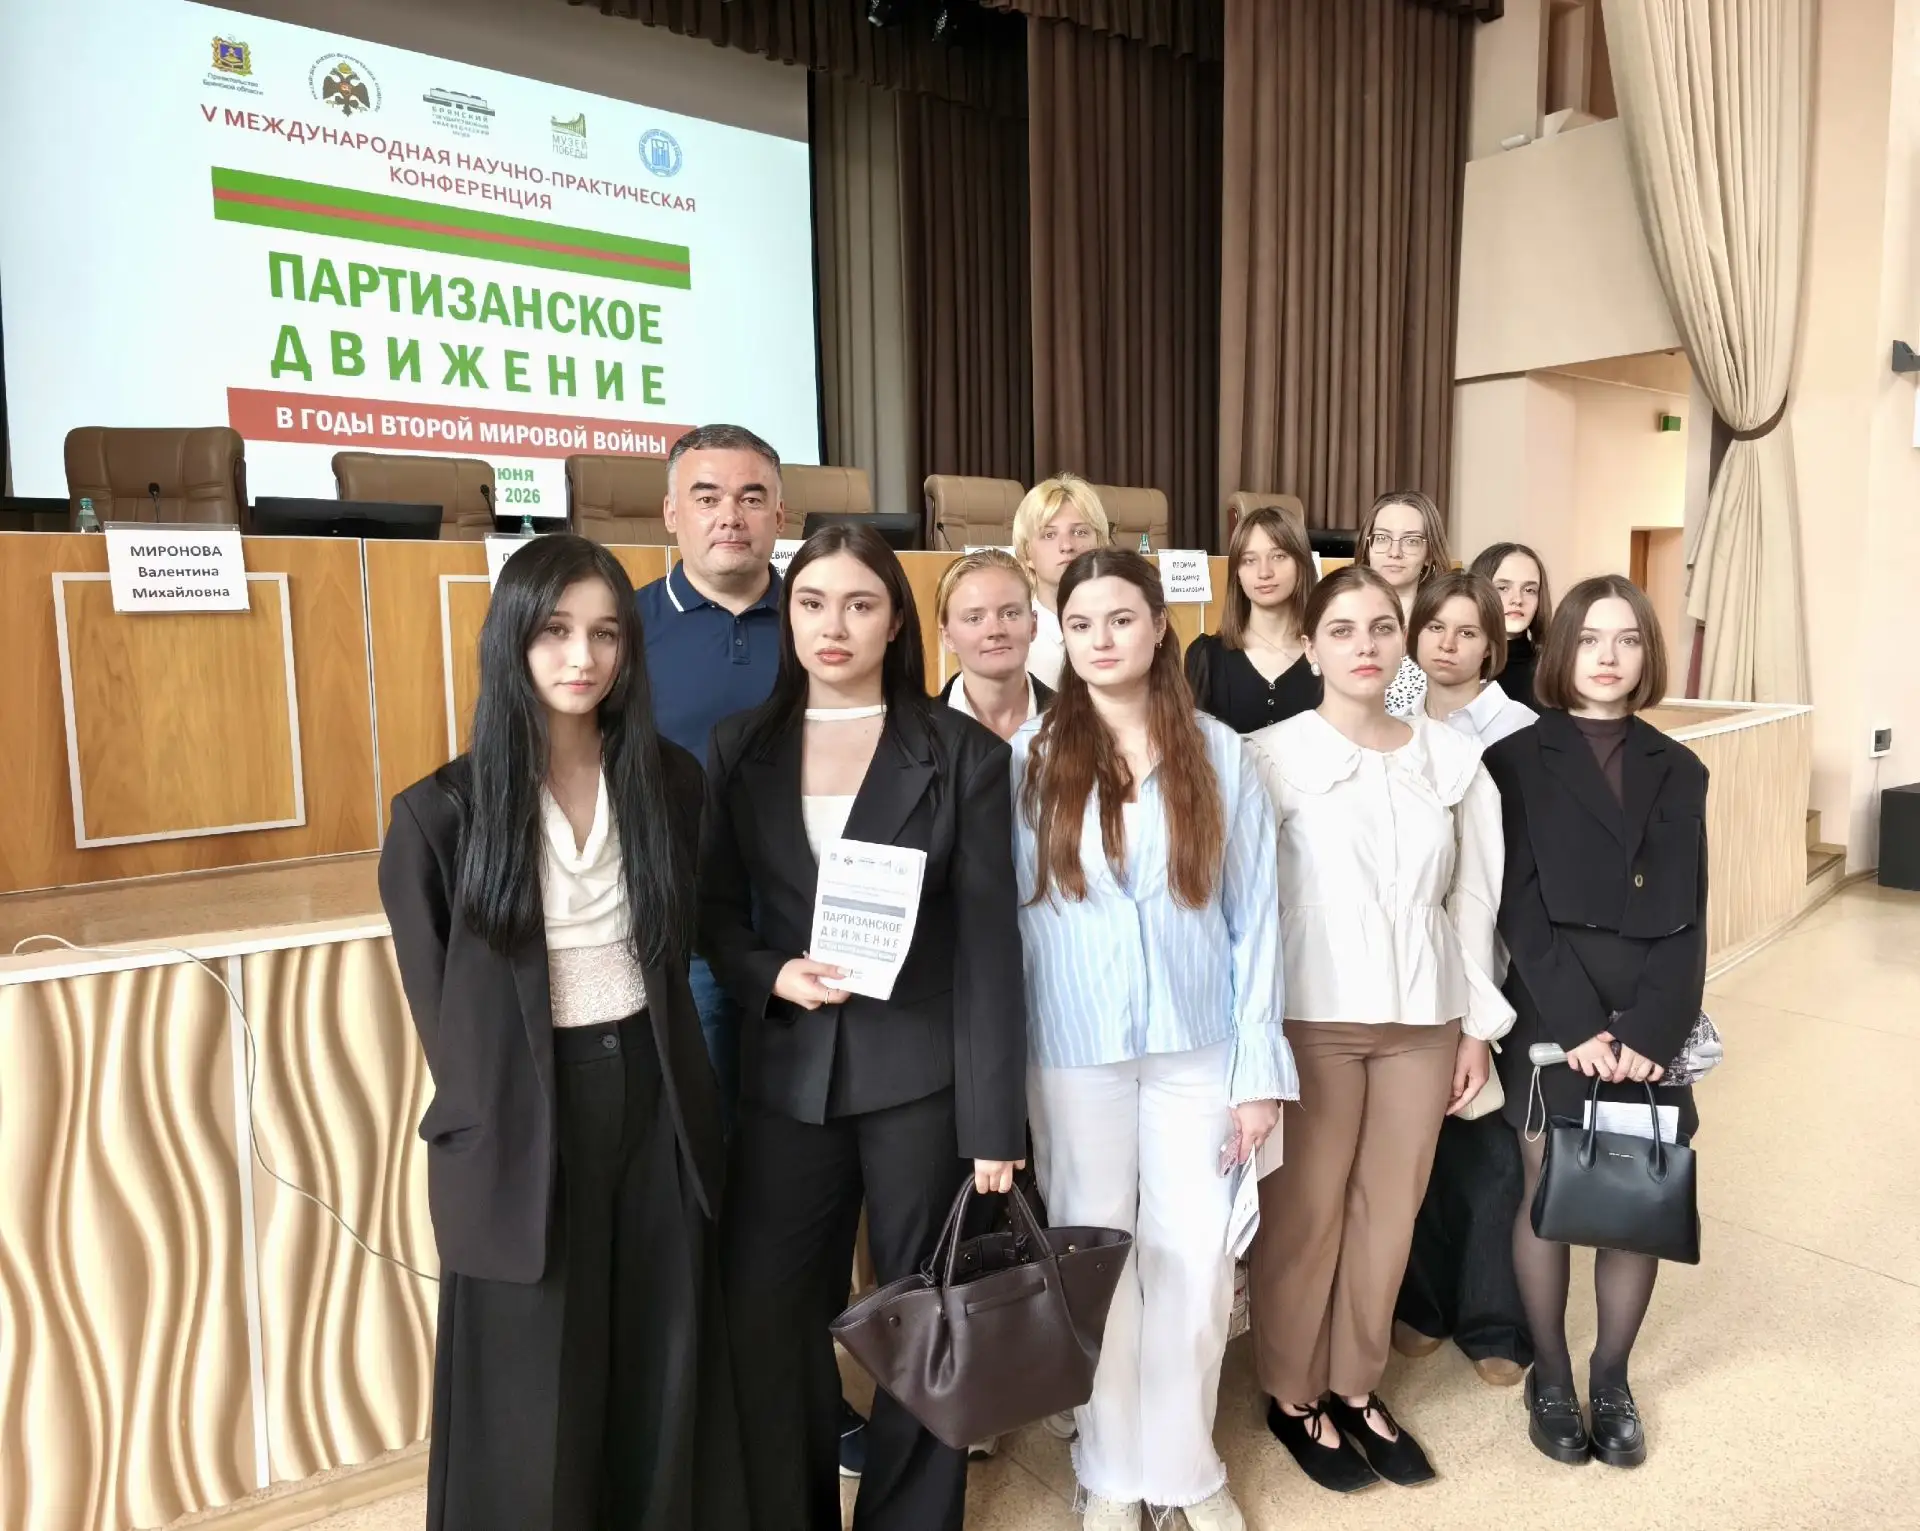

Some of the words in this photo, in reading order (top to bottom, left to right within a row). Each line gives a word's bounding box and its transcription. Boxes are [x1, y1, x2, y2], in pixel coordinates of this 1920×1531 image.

[552, 133, 589, 150] МУЗЕЙ
[200, 103, 218, 123] V
[224, 108, 451, 167] МЕЖДУНАРОДНАЯ
[456, 152, 697, 213] НАУЧНО-ПРАКТИЧЕСКАЯ
[552, 144, 588, 160] ПОБЕДЫ
[389, 165, 553, 211] КОНФЕРЕНЦИЯ
[268, 250, 664, 345] ПАРТИЗАНСКОЕ
[270, 324, 666, 406] ДВИЖЕНИЕ
[276, 406, 294, 429] В
[300, 408, 374, 437] ГОДЫ
[381, 414, 474, 442] ВТОРОЙ
[479, 422, 588, 450] МИРОВОЙ
[593, 428, 667, 455] ВОЙНЫ
[497, 467, 535, 482] ЮНЯ
[505, 487, 541, 504] 2026
[130, 545, 223, 557] МИРОНОВА
[138, 566, 219, 578] Валентина
[132, 586, 230, 599] Михайловна
[822, 910, 903, 933] ПАРТИЗАНСКОЕ
[820, 925, 900, 949] ДВИЖЕНИЕ
